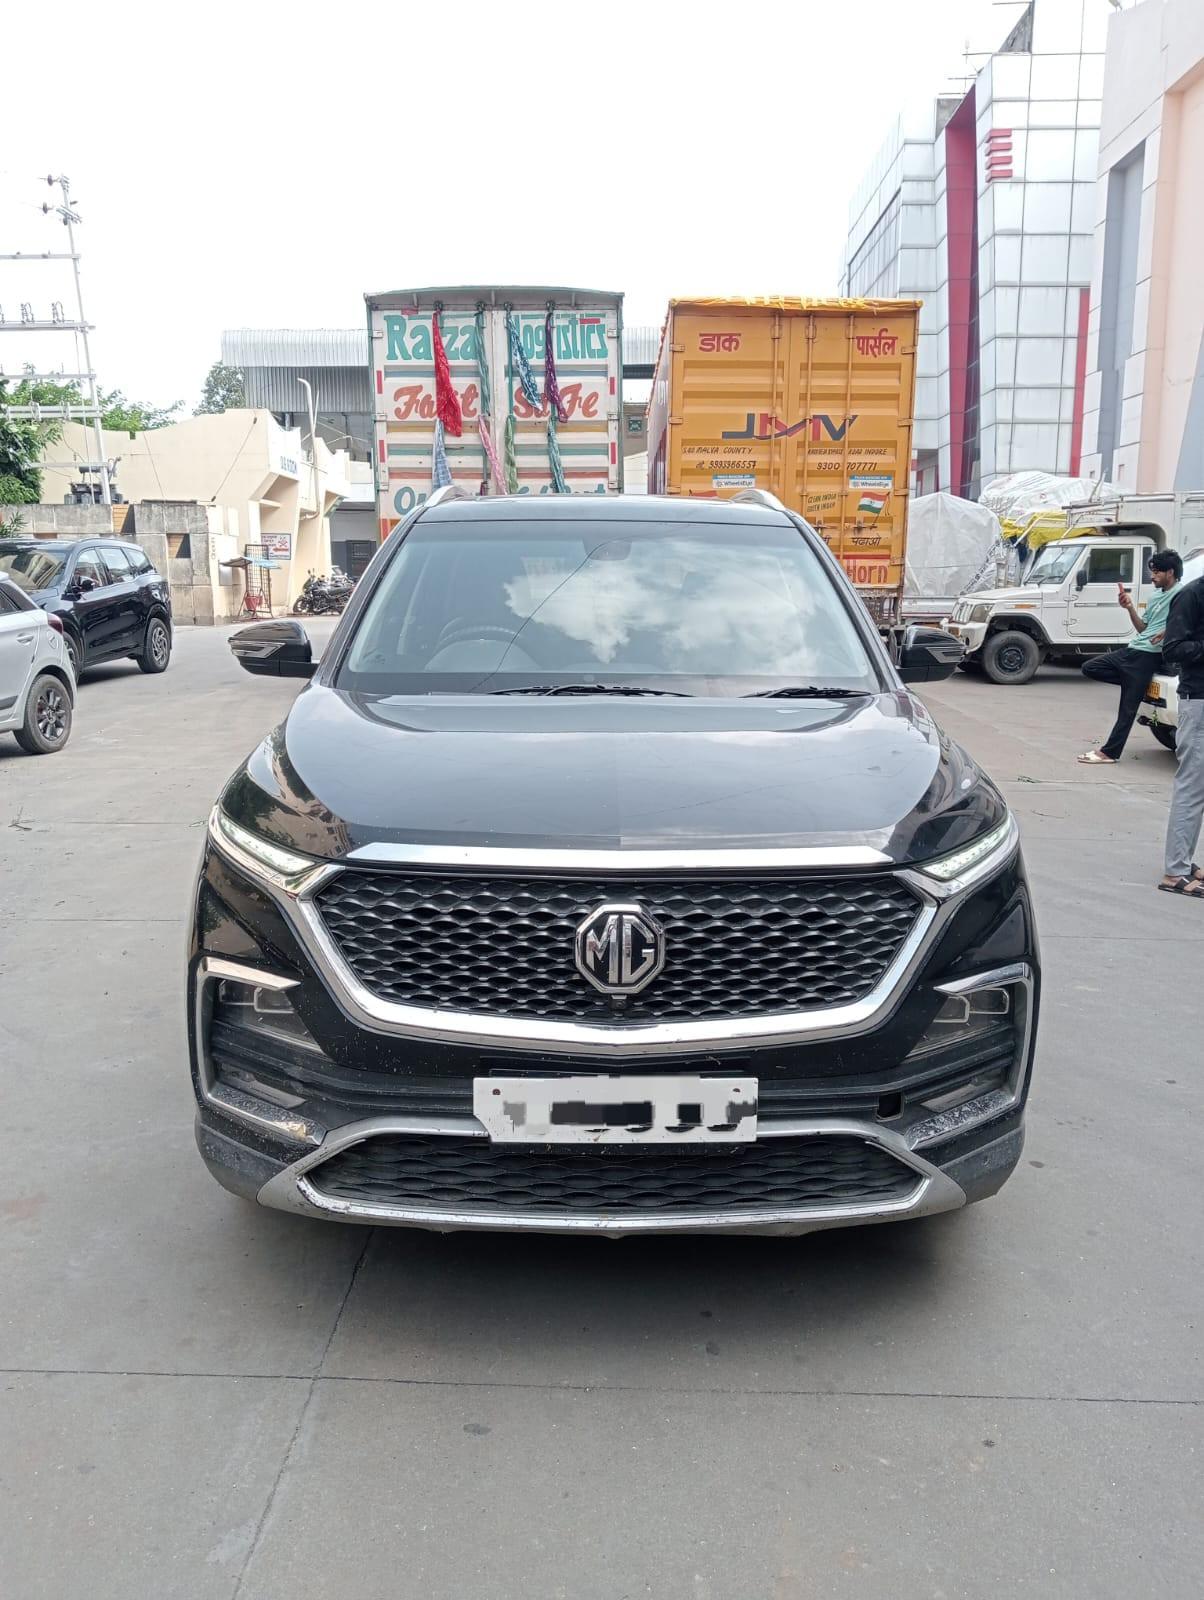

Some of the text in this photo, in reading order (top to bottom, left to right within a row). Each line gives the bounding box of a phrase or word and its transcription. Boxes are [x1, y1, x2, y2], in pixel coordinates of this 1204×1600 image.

[699, 328, 898, 358] डाक पार्सल
[394, 384, 478, 419] Fat
[817, 462, 840, 470] 9300
[847, 560, 888, 583] Horn
[586, 914, 655, 984] MG
